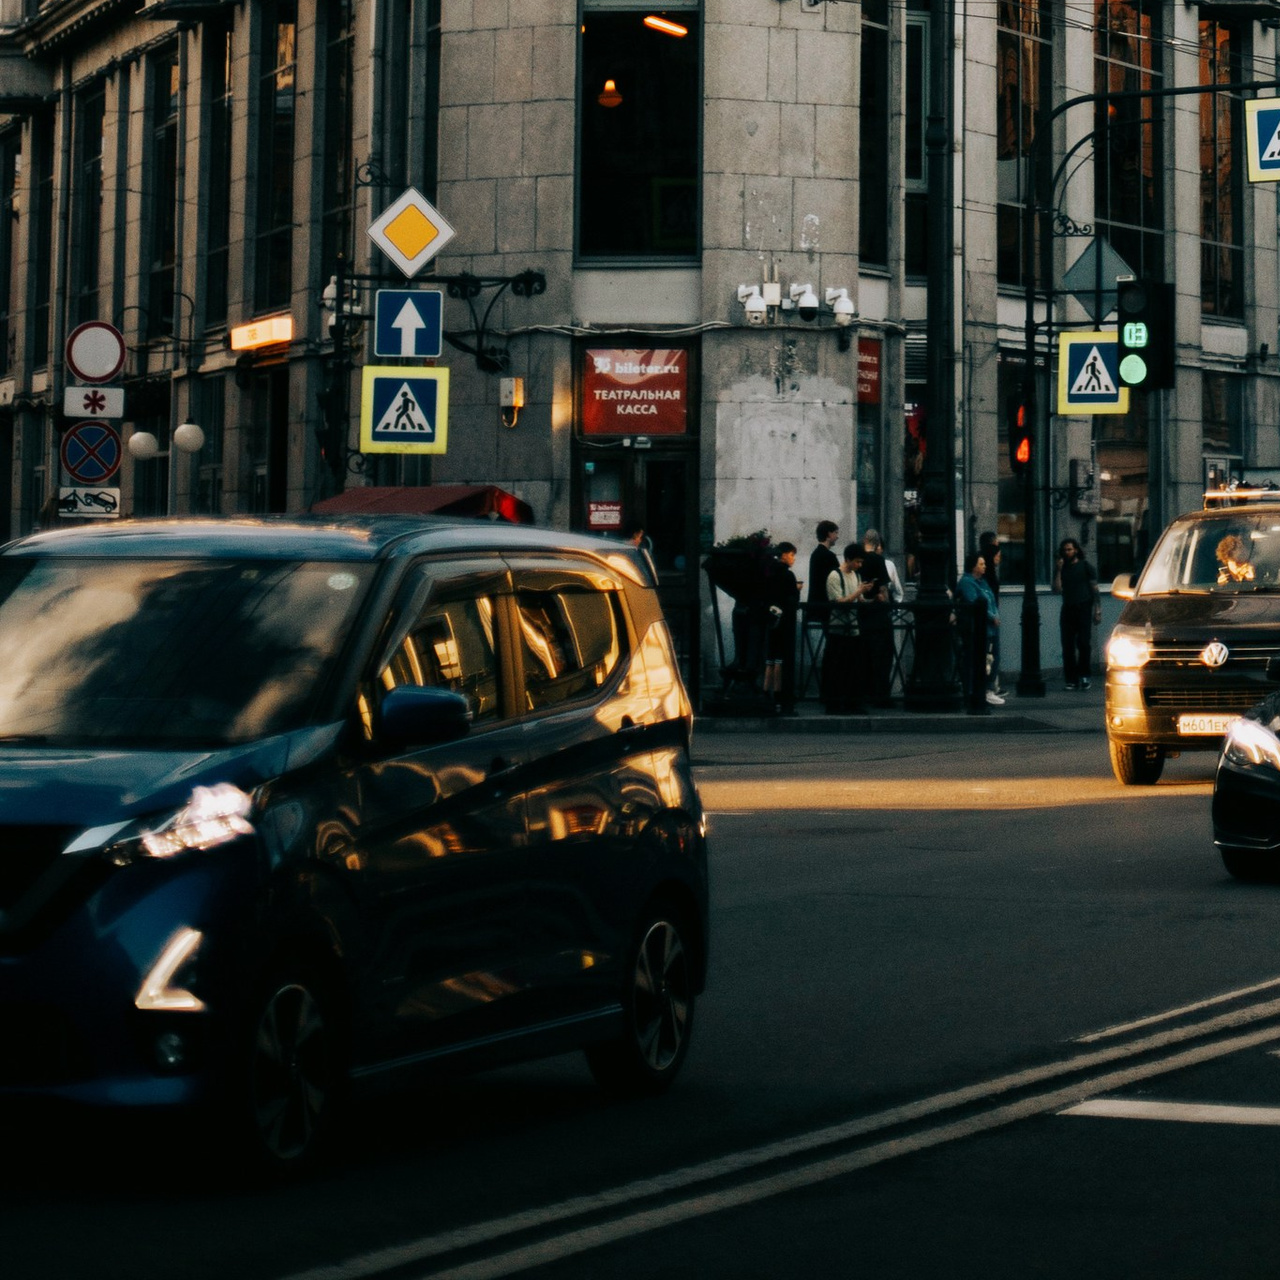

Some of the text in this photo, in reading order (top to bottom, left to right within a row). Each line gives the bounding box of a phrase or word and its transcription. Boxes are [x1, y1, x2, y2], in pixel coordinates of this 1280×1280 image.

[614, 362, 680, 374] bileter.ru
[593, 390, 681, 400] ТЕАТРАЛЬНАЯ
[616, 404, 658, 414] КАССА
